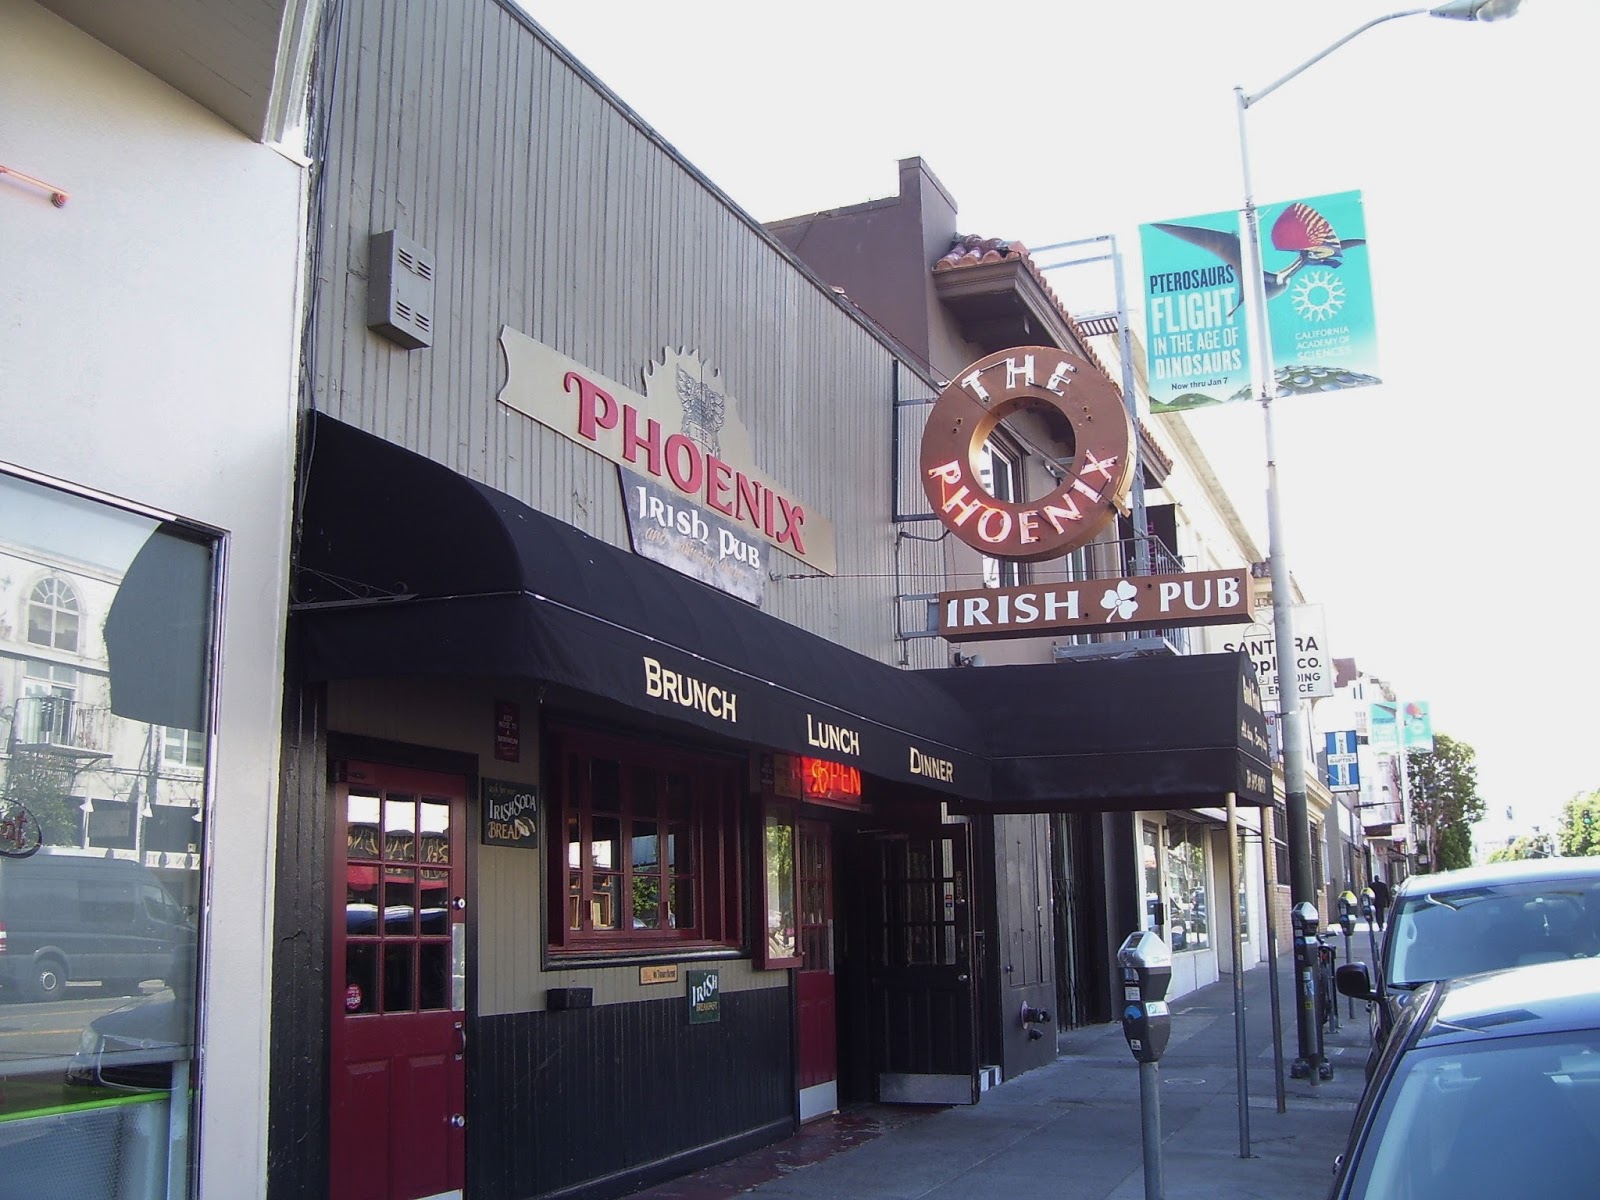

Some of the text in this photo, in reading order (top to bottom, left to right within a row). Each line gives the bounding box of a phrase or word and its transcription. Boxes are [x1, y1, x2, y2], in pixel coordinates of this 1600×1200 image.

[1150, 264, 1234, 294] PTEROSAURS
[1151, 287, 1236, 335] FLIGHT
[1153, 327, 1240, 357] IN THE AGE OF
[1295, 326, 1350, 341] CALIFORNIA
[1296, 335, 1351, 350] ACADEMY OF
[961, 354, 1077, 402] THE
[1155, 348, 1242, 380] DINOSAURS
[1171, 377, 1229, 391] Now thru Jan 7
[563, 371, 806, 555] PHOENIX
[928, 449, 1119, 545] PHOENIX
[946, 577, 1240, 628] IRISH PUB
[1223, 637, 1319, 656] SANTRA
[643, 656, 737, 723] BRUNCH
[807, 713, 860, 756] LUNCH
[909, 746, 954, 783] DINNER
[487, 821, 522, 840] BREAD
